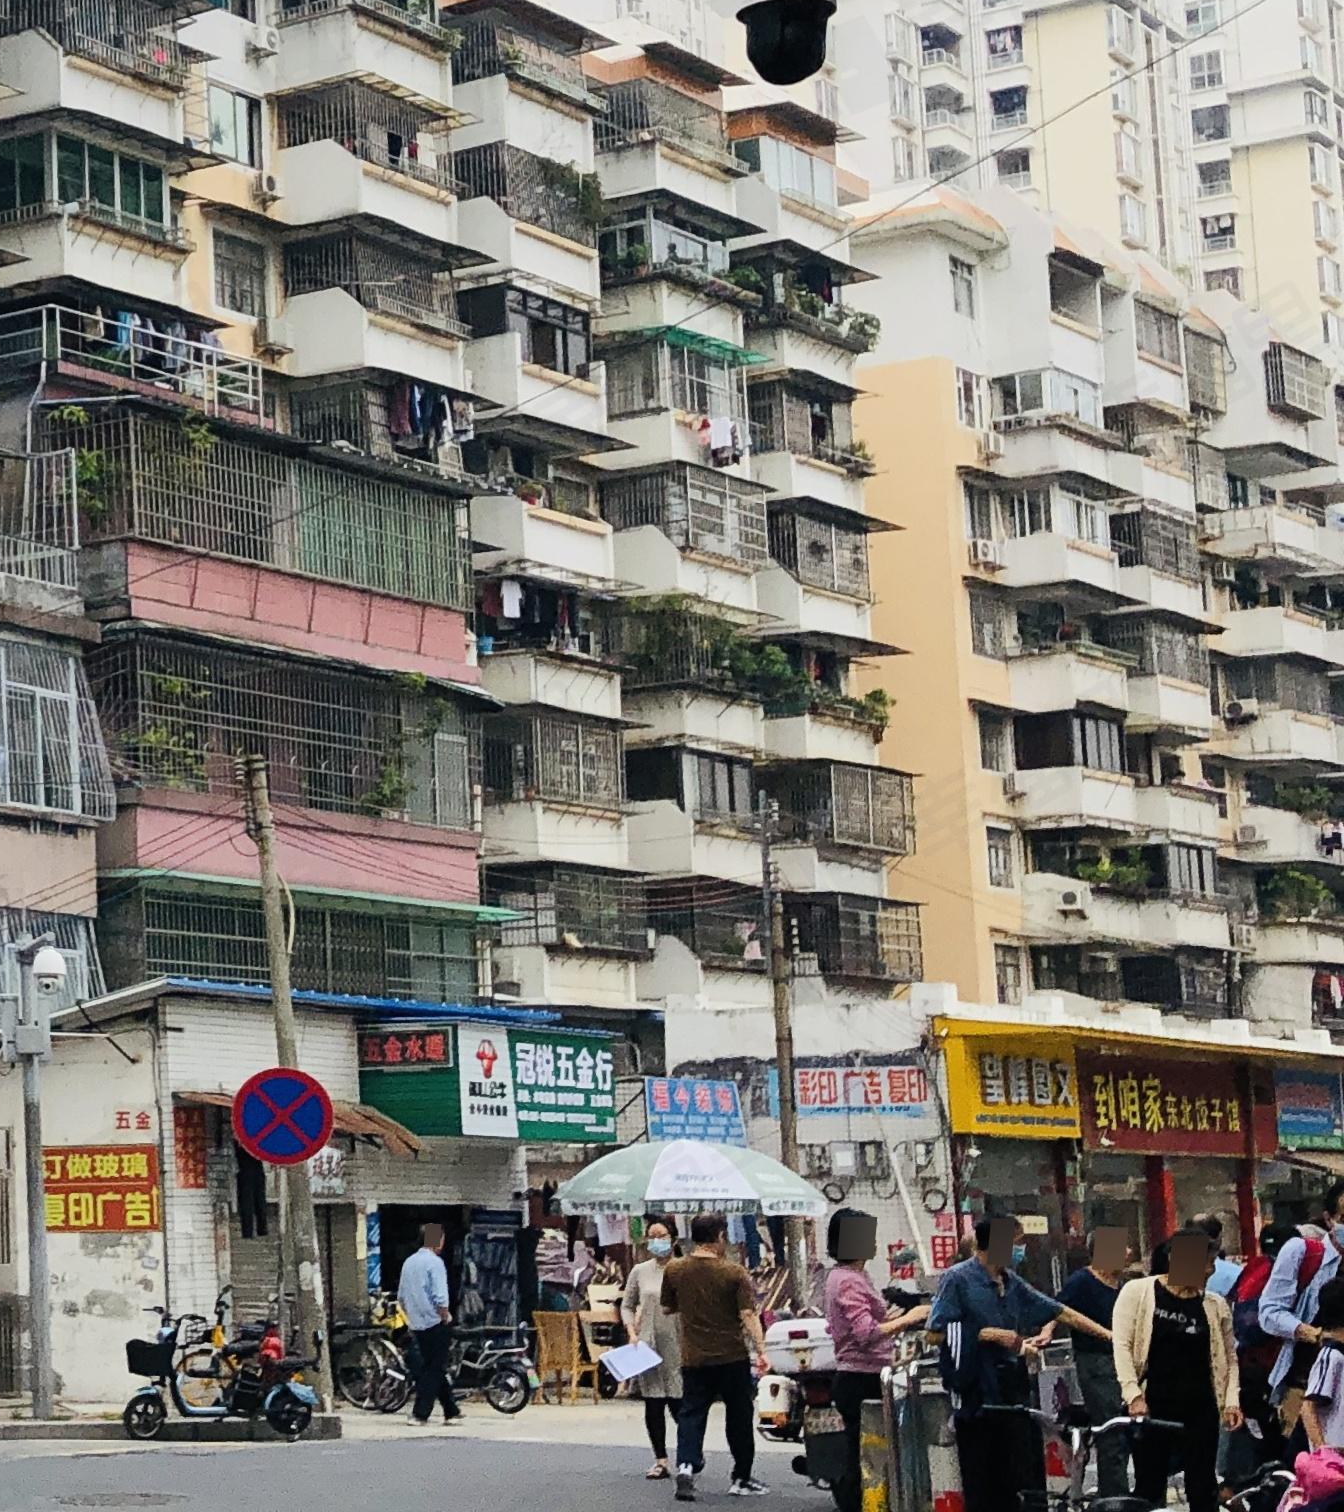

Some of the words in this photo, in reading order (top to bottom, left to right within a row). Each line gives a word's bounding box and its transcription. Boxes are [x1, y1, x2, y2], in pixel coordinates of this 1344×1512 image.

[515, 1042, 613, 1091] 冠锐五金行
[116, 1111, 151, 1130] 五金
[43, 1153, 148, 1179] 订做玻璃
[44, 1192, 151, 1227] 复印广告
